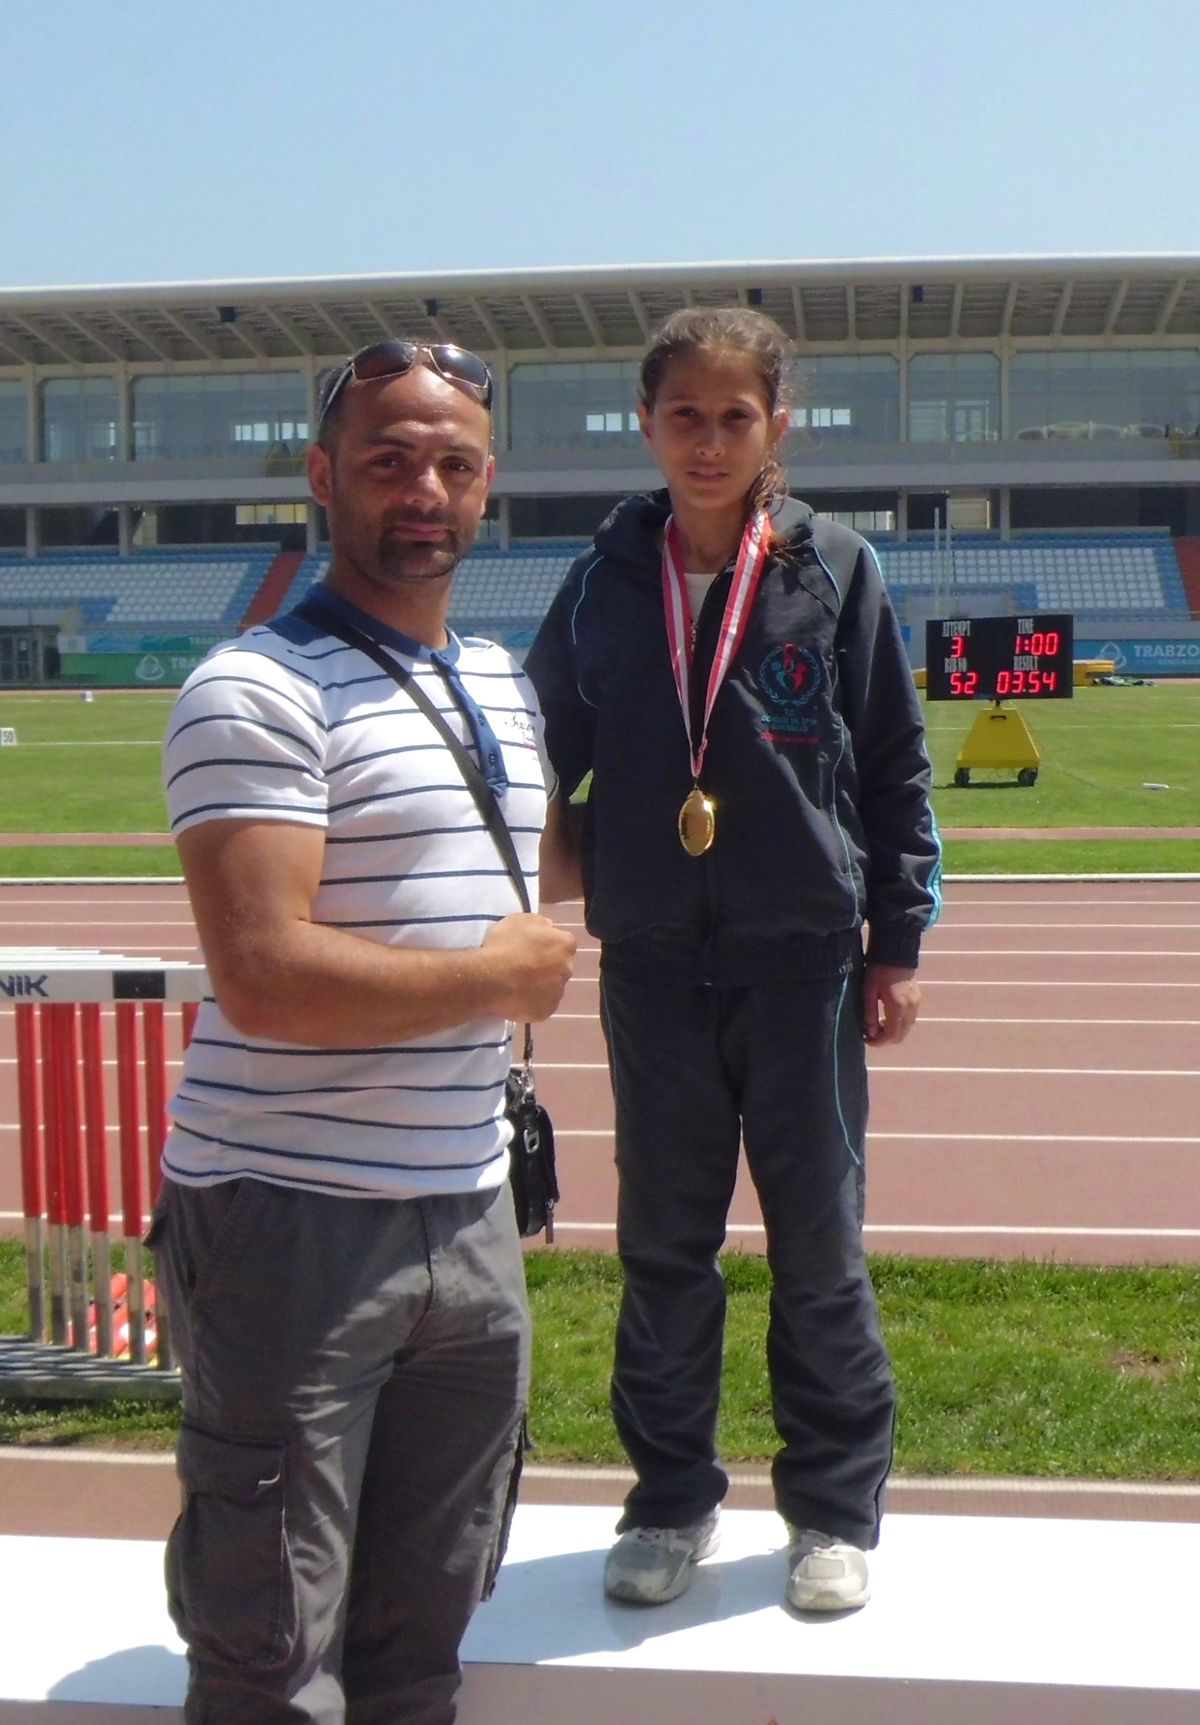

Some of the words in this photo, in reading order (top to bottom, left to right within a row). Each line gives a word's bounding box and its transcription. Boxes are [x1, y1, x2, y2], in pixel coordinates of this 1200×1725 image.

[943, 621, 971, 637] ATTEMPT
[1017, 618, 1033, 634] TIME
[950, 636, 963, 658] 3
[1014, 632, 1058, 655] 1:00
[1013, 655, 1038, 671] RESULT
[950, 672, 976, 694] 52
[996, 671, 1056, 693] 03.54
